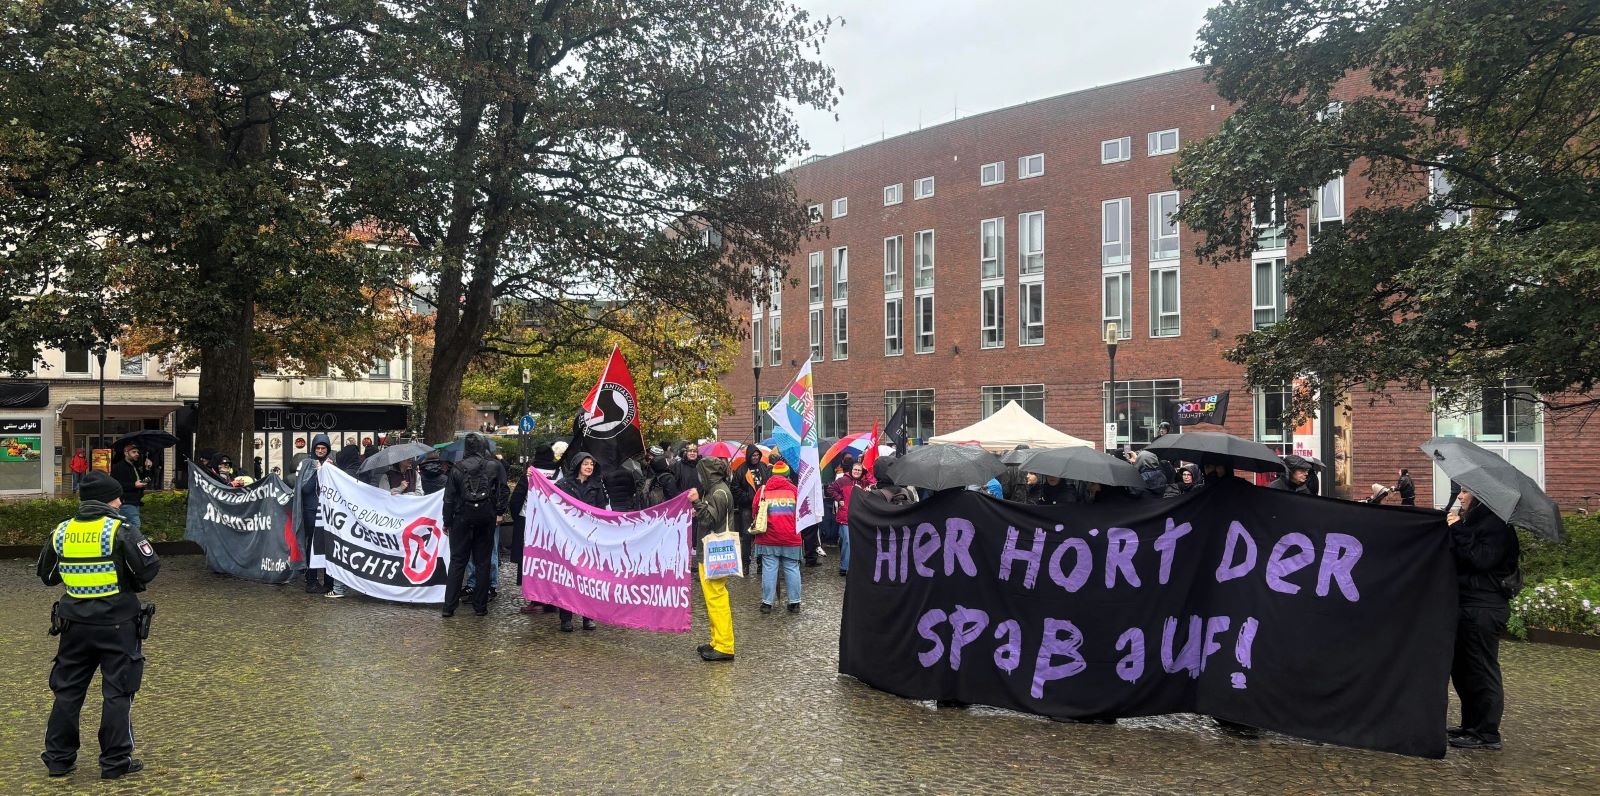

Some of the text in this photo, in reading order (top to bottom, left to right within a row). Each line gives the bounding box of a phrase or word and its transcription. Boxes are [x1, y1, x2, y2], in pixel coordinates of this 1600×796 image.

[358, 509, 405, 530] BÜNDNIS
[64, 531, 101, 544] POLIZEI
[350, 521, 400, 551] GEGEN
[332, 540, 401, 580] RECHTS
[577, 575, 611, 602] GEGEN
[614, 583, 689, 609] RASSISMUS
